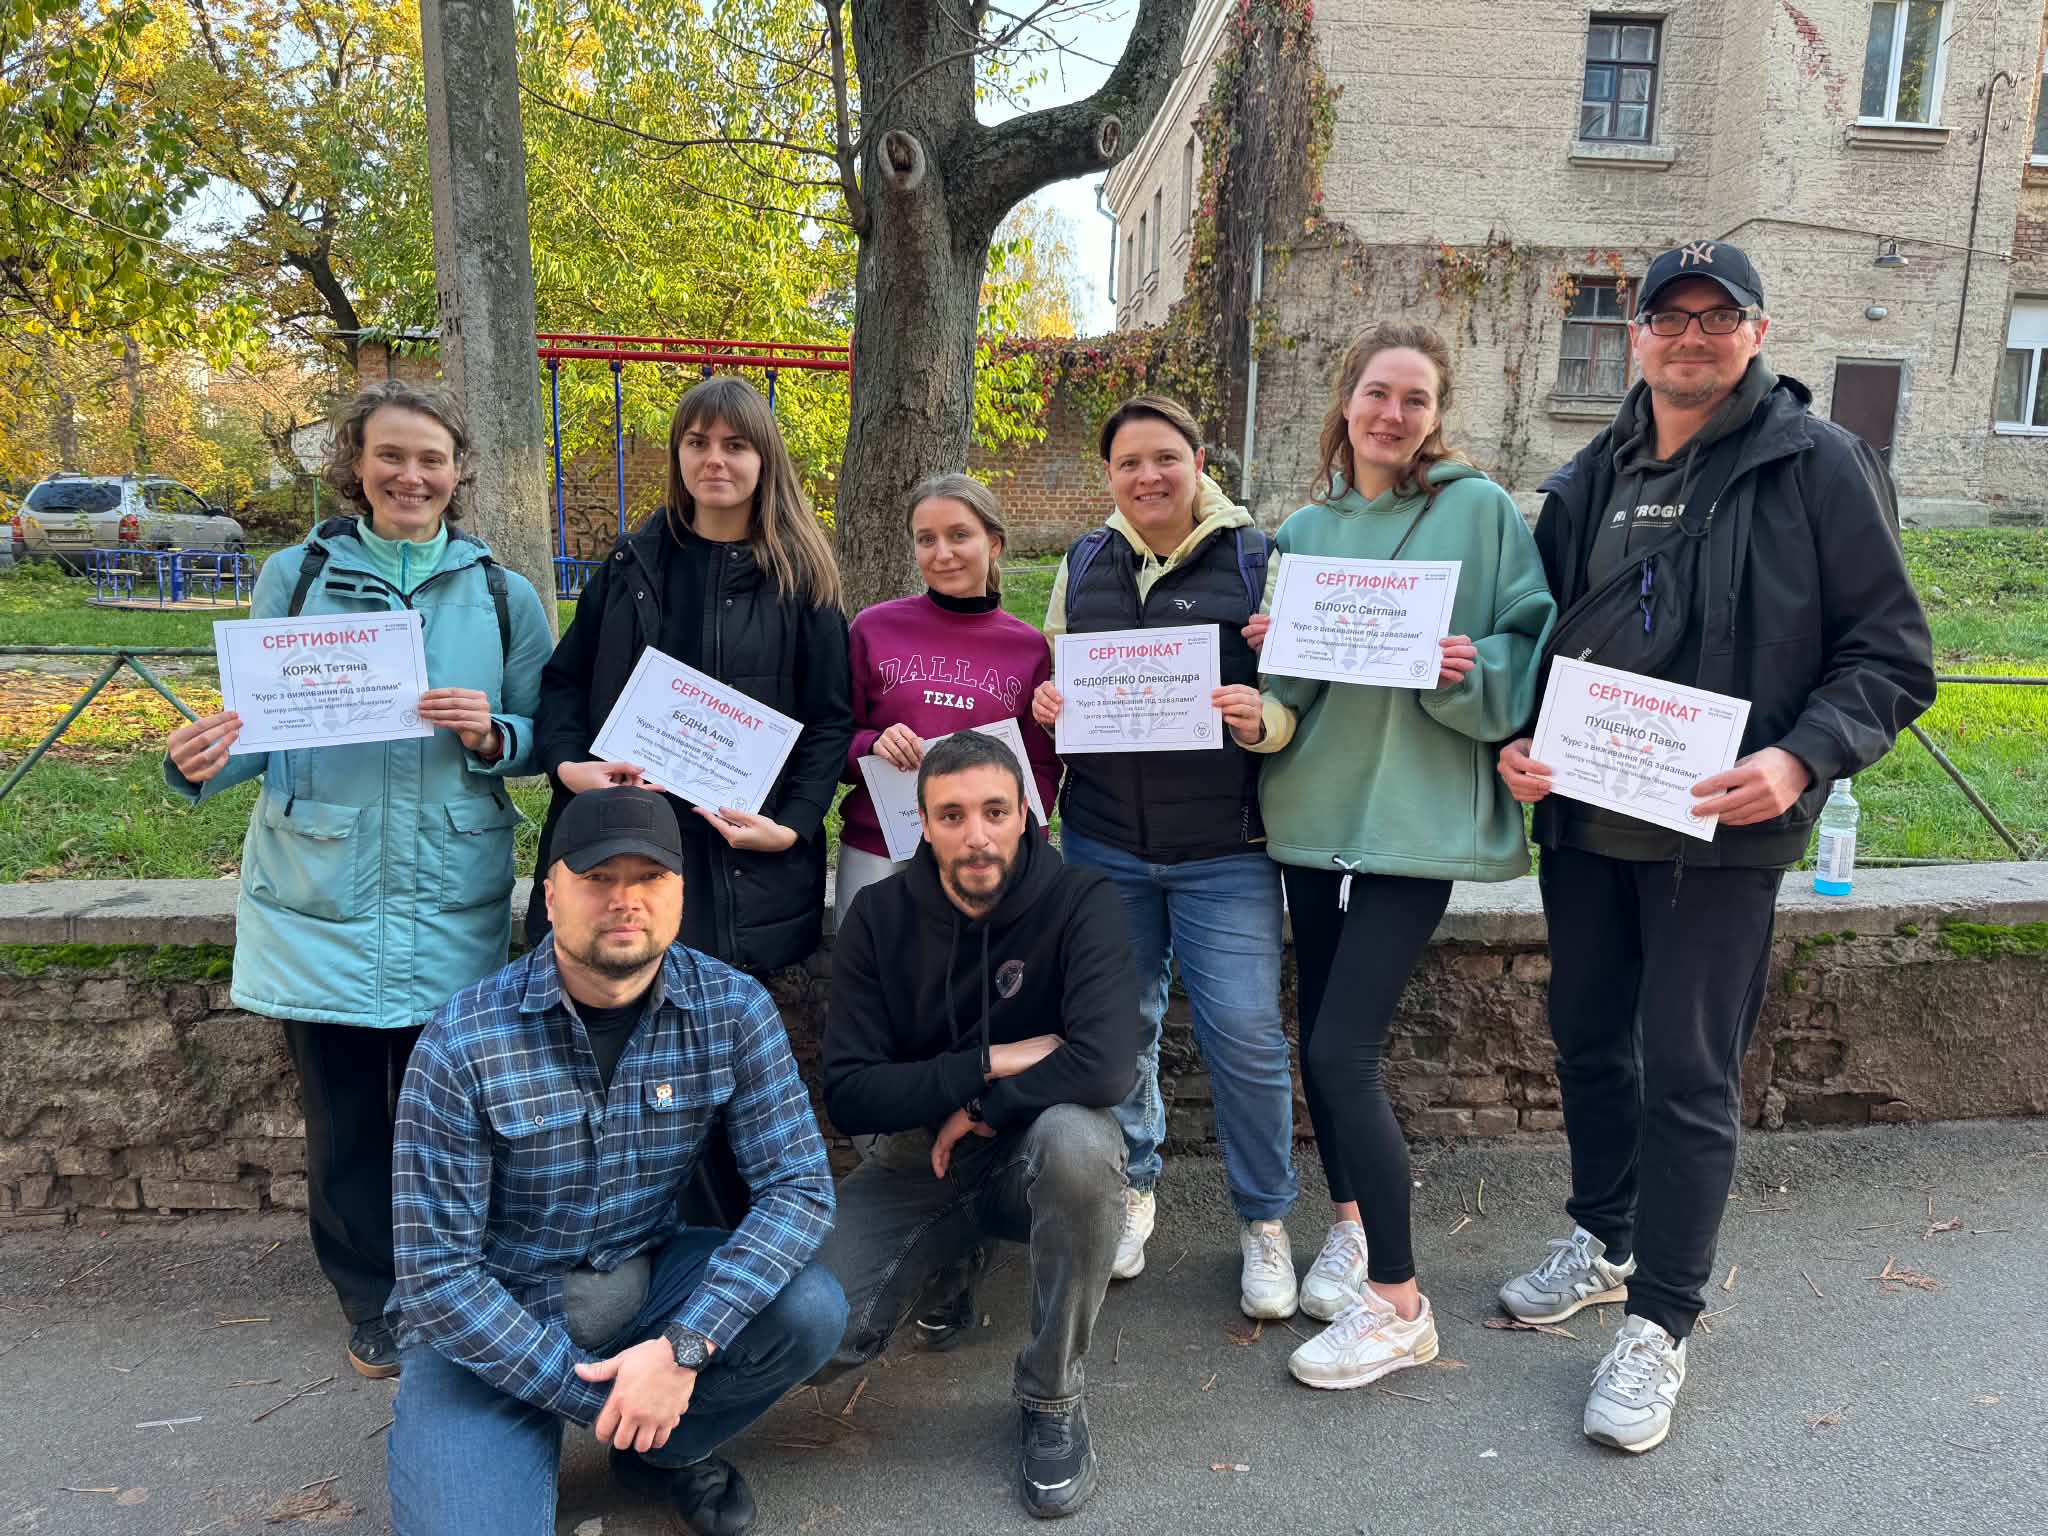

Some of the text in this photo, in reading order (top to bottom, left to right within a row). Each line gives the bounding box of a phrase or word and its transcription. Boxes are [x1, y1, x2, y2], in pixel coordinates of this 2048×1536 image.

[1315, 572, 1419, 590] СЕРТИФІКАТ
[1313, 601, 1407, 617] БІЛОУС Світлана
[262, 628, 380, 649] СЕРТИФІКАТ
[1088, 642, 1182, 660] СЕРТИФІКАТ
[281, 661, 367, 676] КОРЖ Тетяна
[878, 654, 1021, 712] DALLAS
[1073, 671, 1199, 688] ФЕДОРЕНКО Олександра
[251, 691, 278, 702] "Курс
[339, 686, 354, 695] під
[669, 676, 763, 732] СЕРТИФІКАТ
[923, 690, 975, 710] TEXAS
[1587, 681, 1702, 723] СЕРТИФІКАТ
[671, 709, 709, 735] БЄДНА
[708, 728, 736, 748] Алла
[1584, 714, 1646, 741] ПУЩЕНКО
[1647, 731, 1687, 751] Павло
[1560, 735, 1583, 749] "Курс
[1639, 756, 1653, 768] під
[1654, 760, 1702, 781] завалами"
